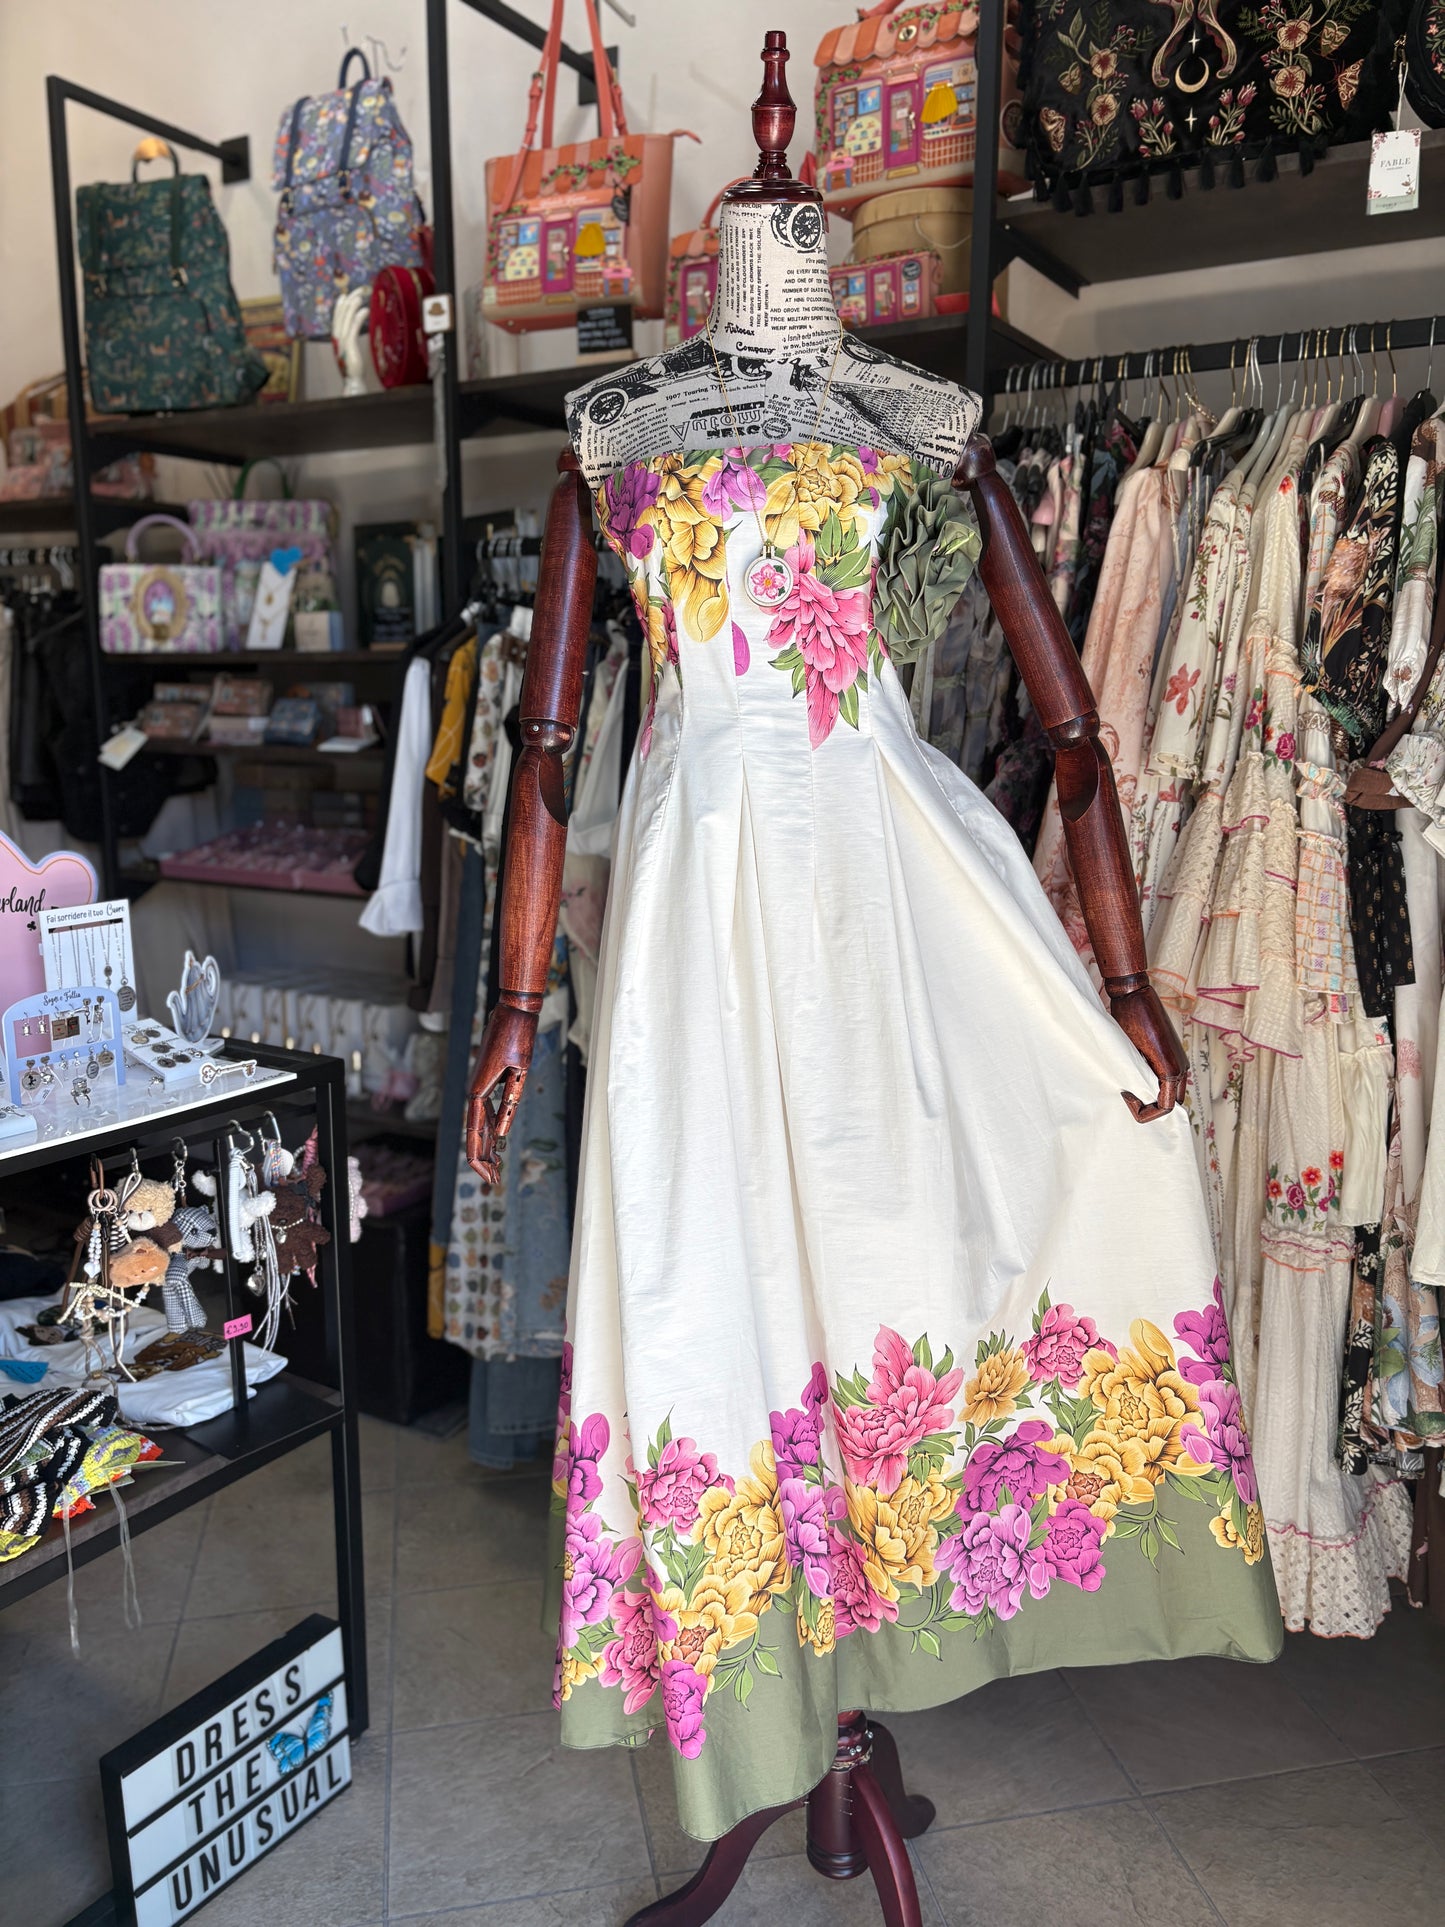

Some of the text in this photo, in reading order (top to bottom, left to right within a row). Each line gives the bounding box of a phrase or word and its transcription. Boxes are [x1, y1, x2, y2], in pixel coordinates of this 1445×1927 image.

[1380, 158, 1411, 168] FABLE
[736, 341, 776, 355] Company
[683, 386, 708, 396] Touring
[46, 915, 57, 924] Fai
[57, 911, 87, 922] sorridere
[92, 909, 104, 917] tuo
[106, 903, 125, 916] Cuore
[175, 1664, 302, 1788] DRESS
[188, 1752, 263, 1836] THE
[172, 1753, 342, 1911] UNUSUAL
